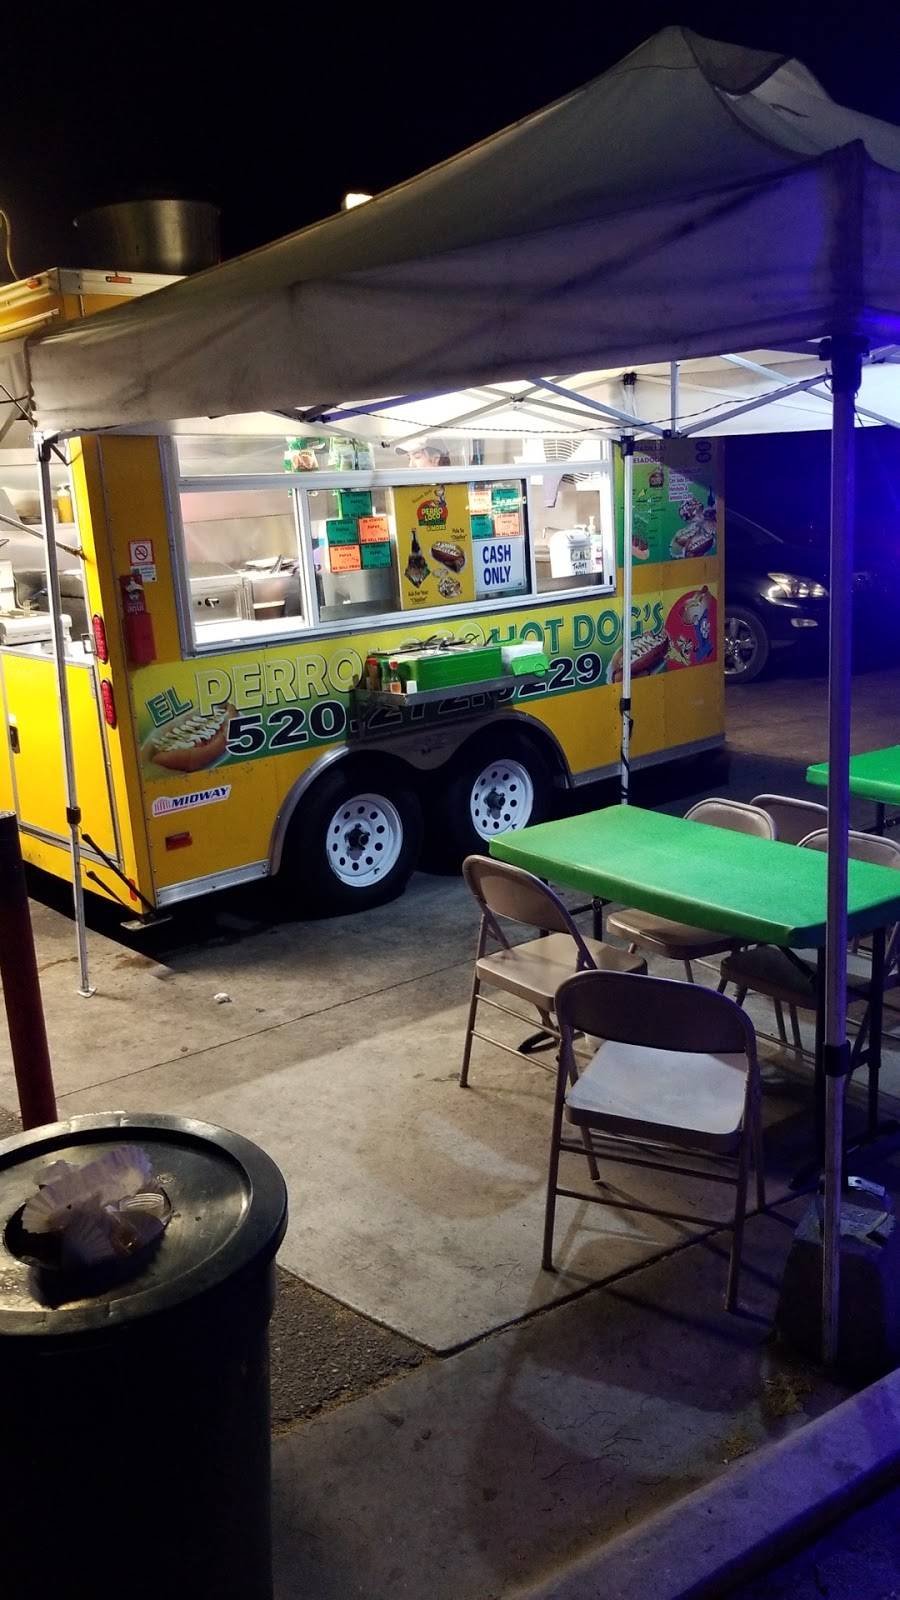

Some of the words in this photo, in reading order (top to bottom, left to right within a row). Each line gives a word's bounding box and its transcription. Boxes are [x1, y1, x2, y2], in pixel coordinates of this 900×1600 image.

[482, 544, 512, 564] CASH
[483, 565, 512, 586] ONLY
[145, 686, 193, 728] EL
[194, 647, 364, 717] PERRO
[489, 616, 564, 655] HOT
[573, 600, 664, 651] DOG'S
[171, 786, 229, 808] MIDWAY
